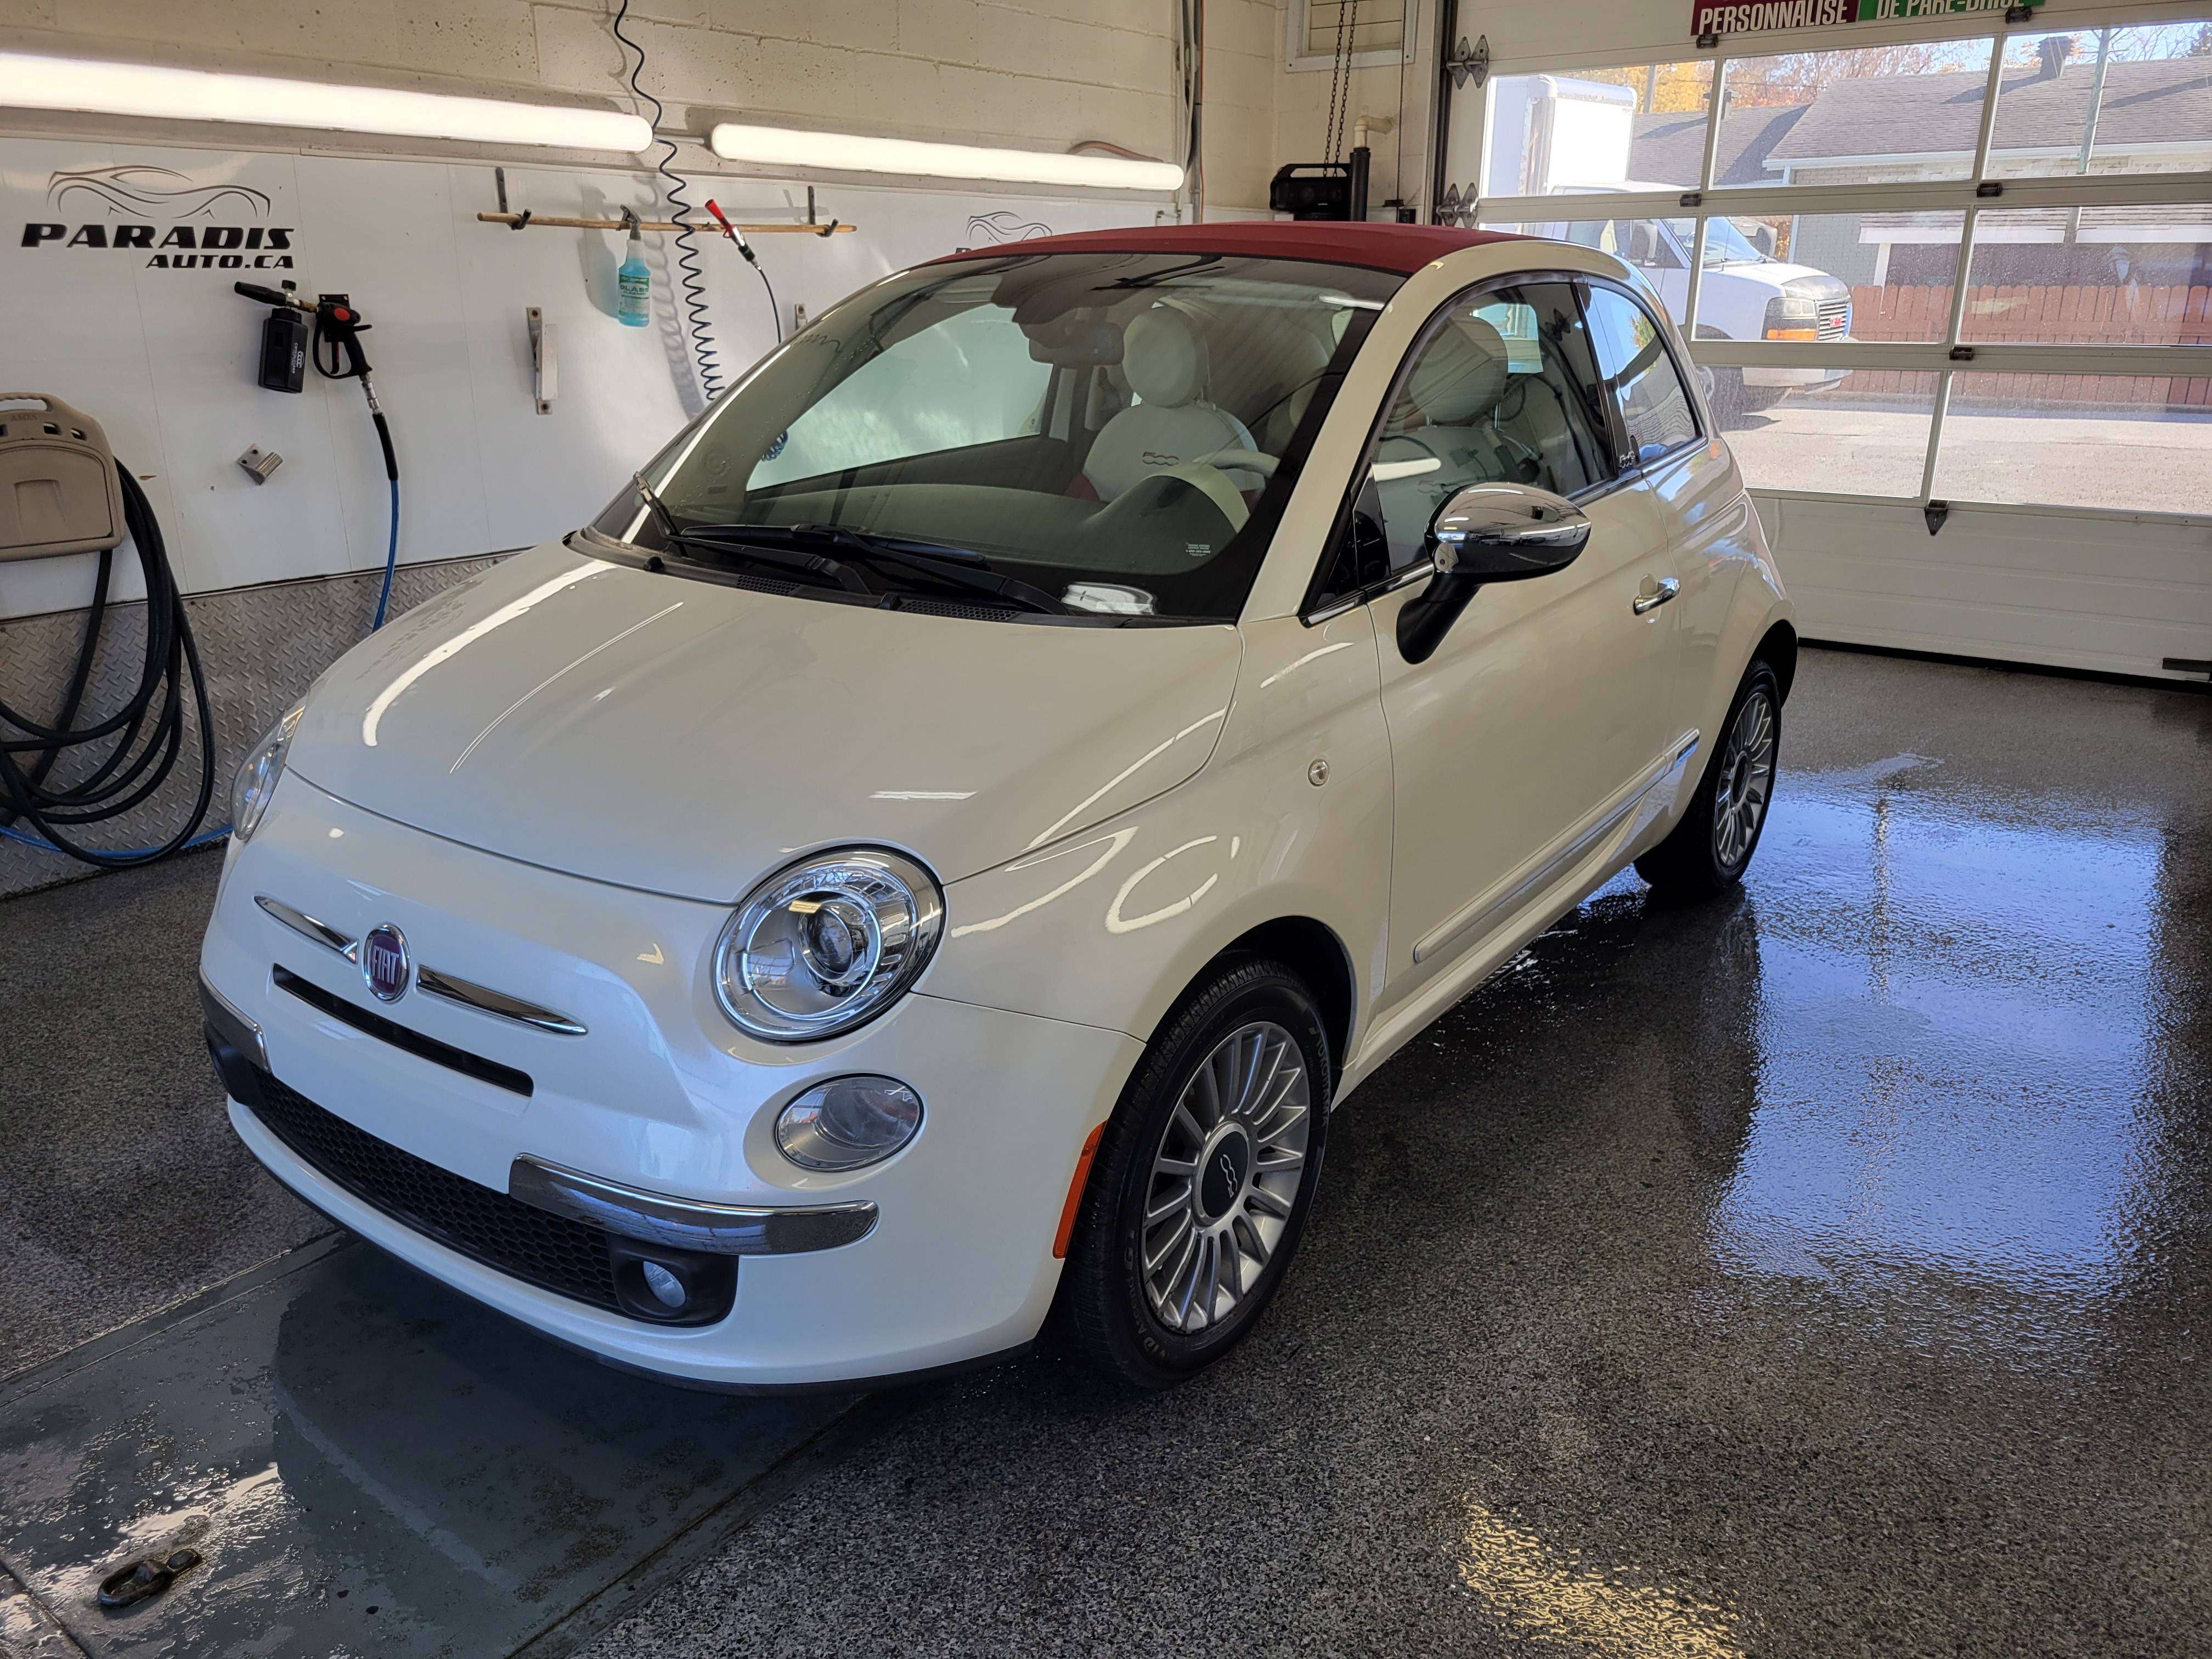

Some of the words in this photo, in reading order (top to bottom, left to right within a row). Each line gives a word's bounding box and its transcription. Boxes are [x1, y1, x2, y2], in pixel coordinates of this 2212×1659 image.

[1876, 0, 1899, 19] DE
[1906, 0, 2024, 16] PARE-
[21, 223, 295, 249] PARADIS
[145, 255, 294, 269] AUTO.CA
[1142, 452, 1180, 467] 500
[372, 944, 399, 985] FIAT
[1316, 1035, 1329, 1128] YOKOHAMA
[1220, 1154, 1238, 1199] 500
